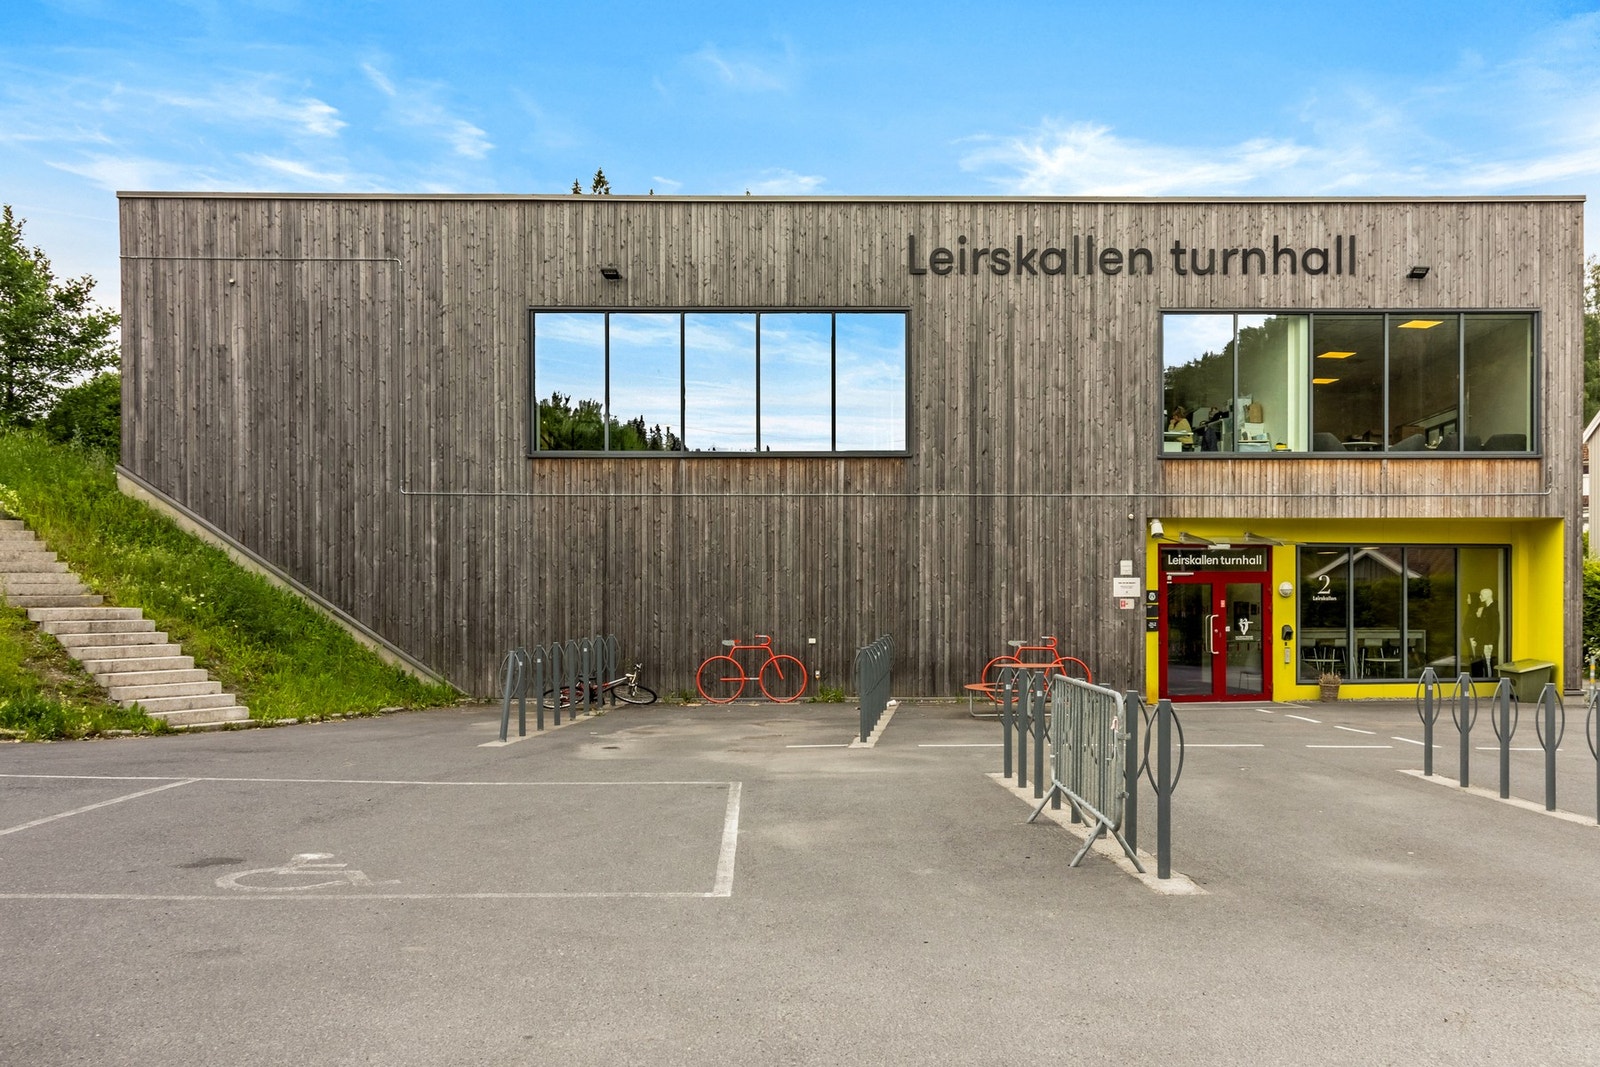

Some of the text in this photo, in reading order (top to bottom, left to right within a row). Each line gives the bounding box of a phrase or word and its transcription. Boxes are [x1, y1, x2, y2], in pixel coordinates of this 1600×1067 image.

[908, 234, 1356, 276] Leirskallen turnhall
[1167, 554, 1262, 565] Leirskallen turnhall
[1317, 574, 1331, 595] 2
